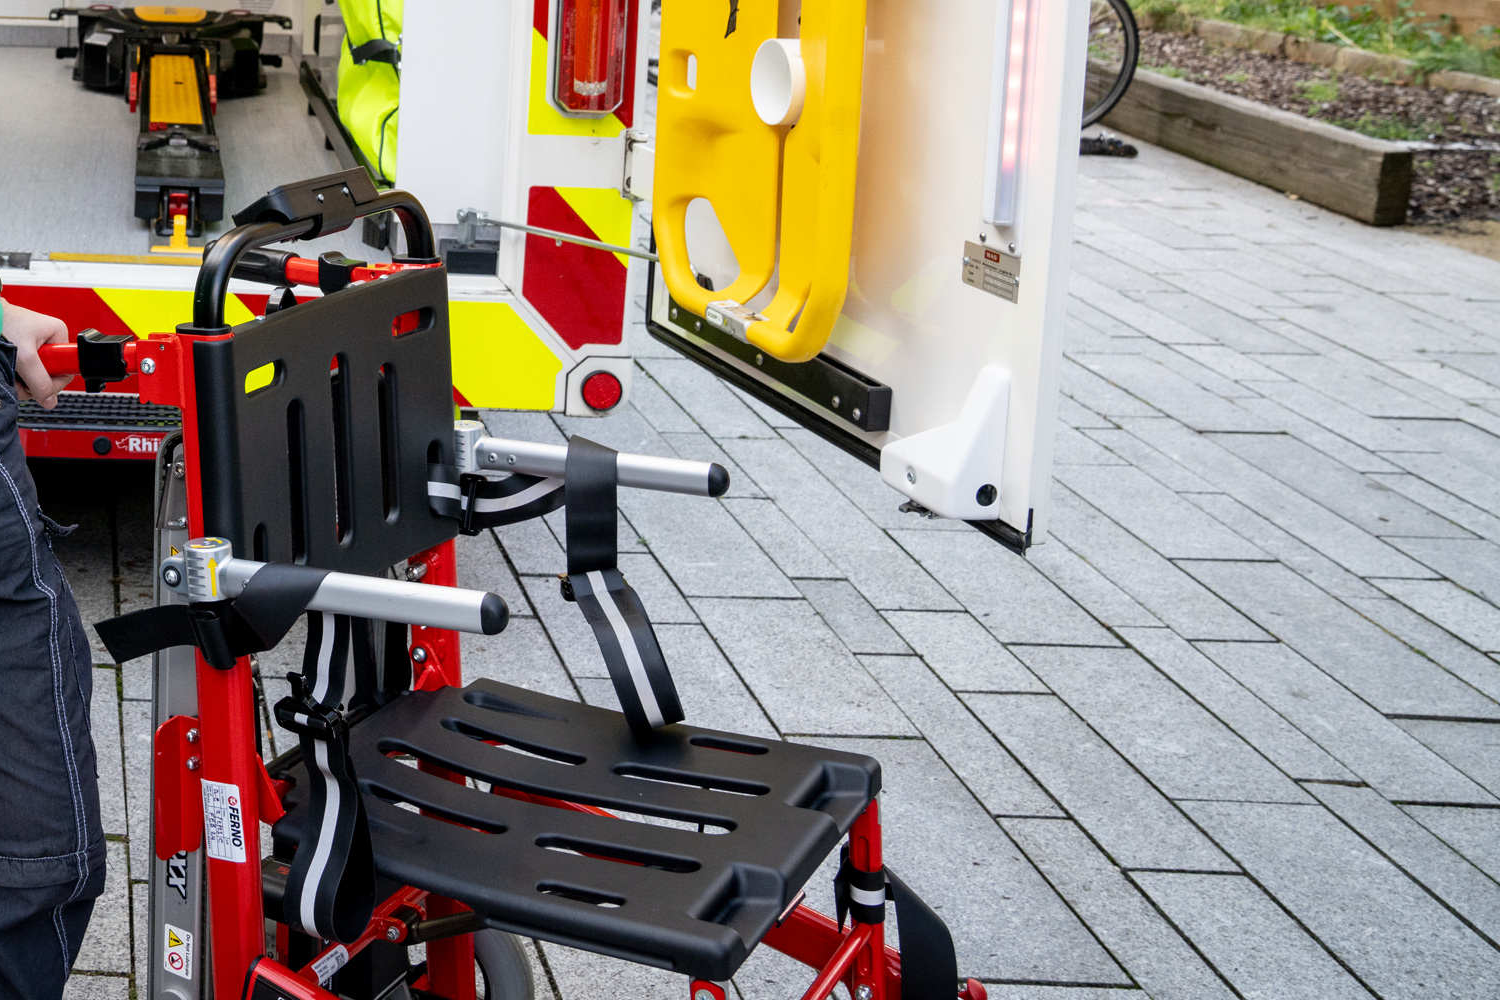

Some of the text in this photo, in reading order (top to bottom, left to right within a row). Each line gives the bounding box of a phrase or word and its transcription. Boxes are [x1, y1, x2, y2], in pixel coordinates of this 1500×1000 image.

[129, 438, 161, 452] Rhi
[229, 806, 242, 847] FERNO
[186, 934, 191, 942] Do
